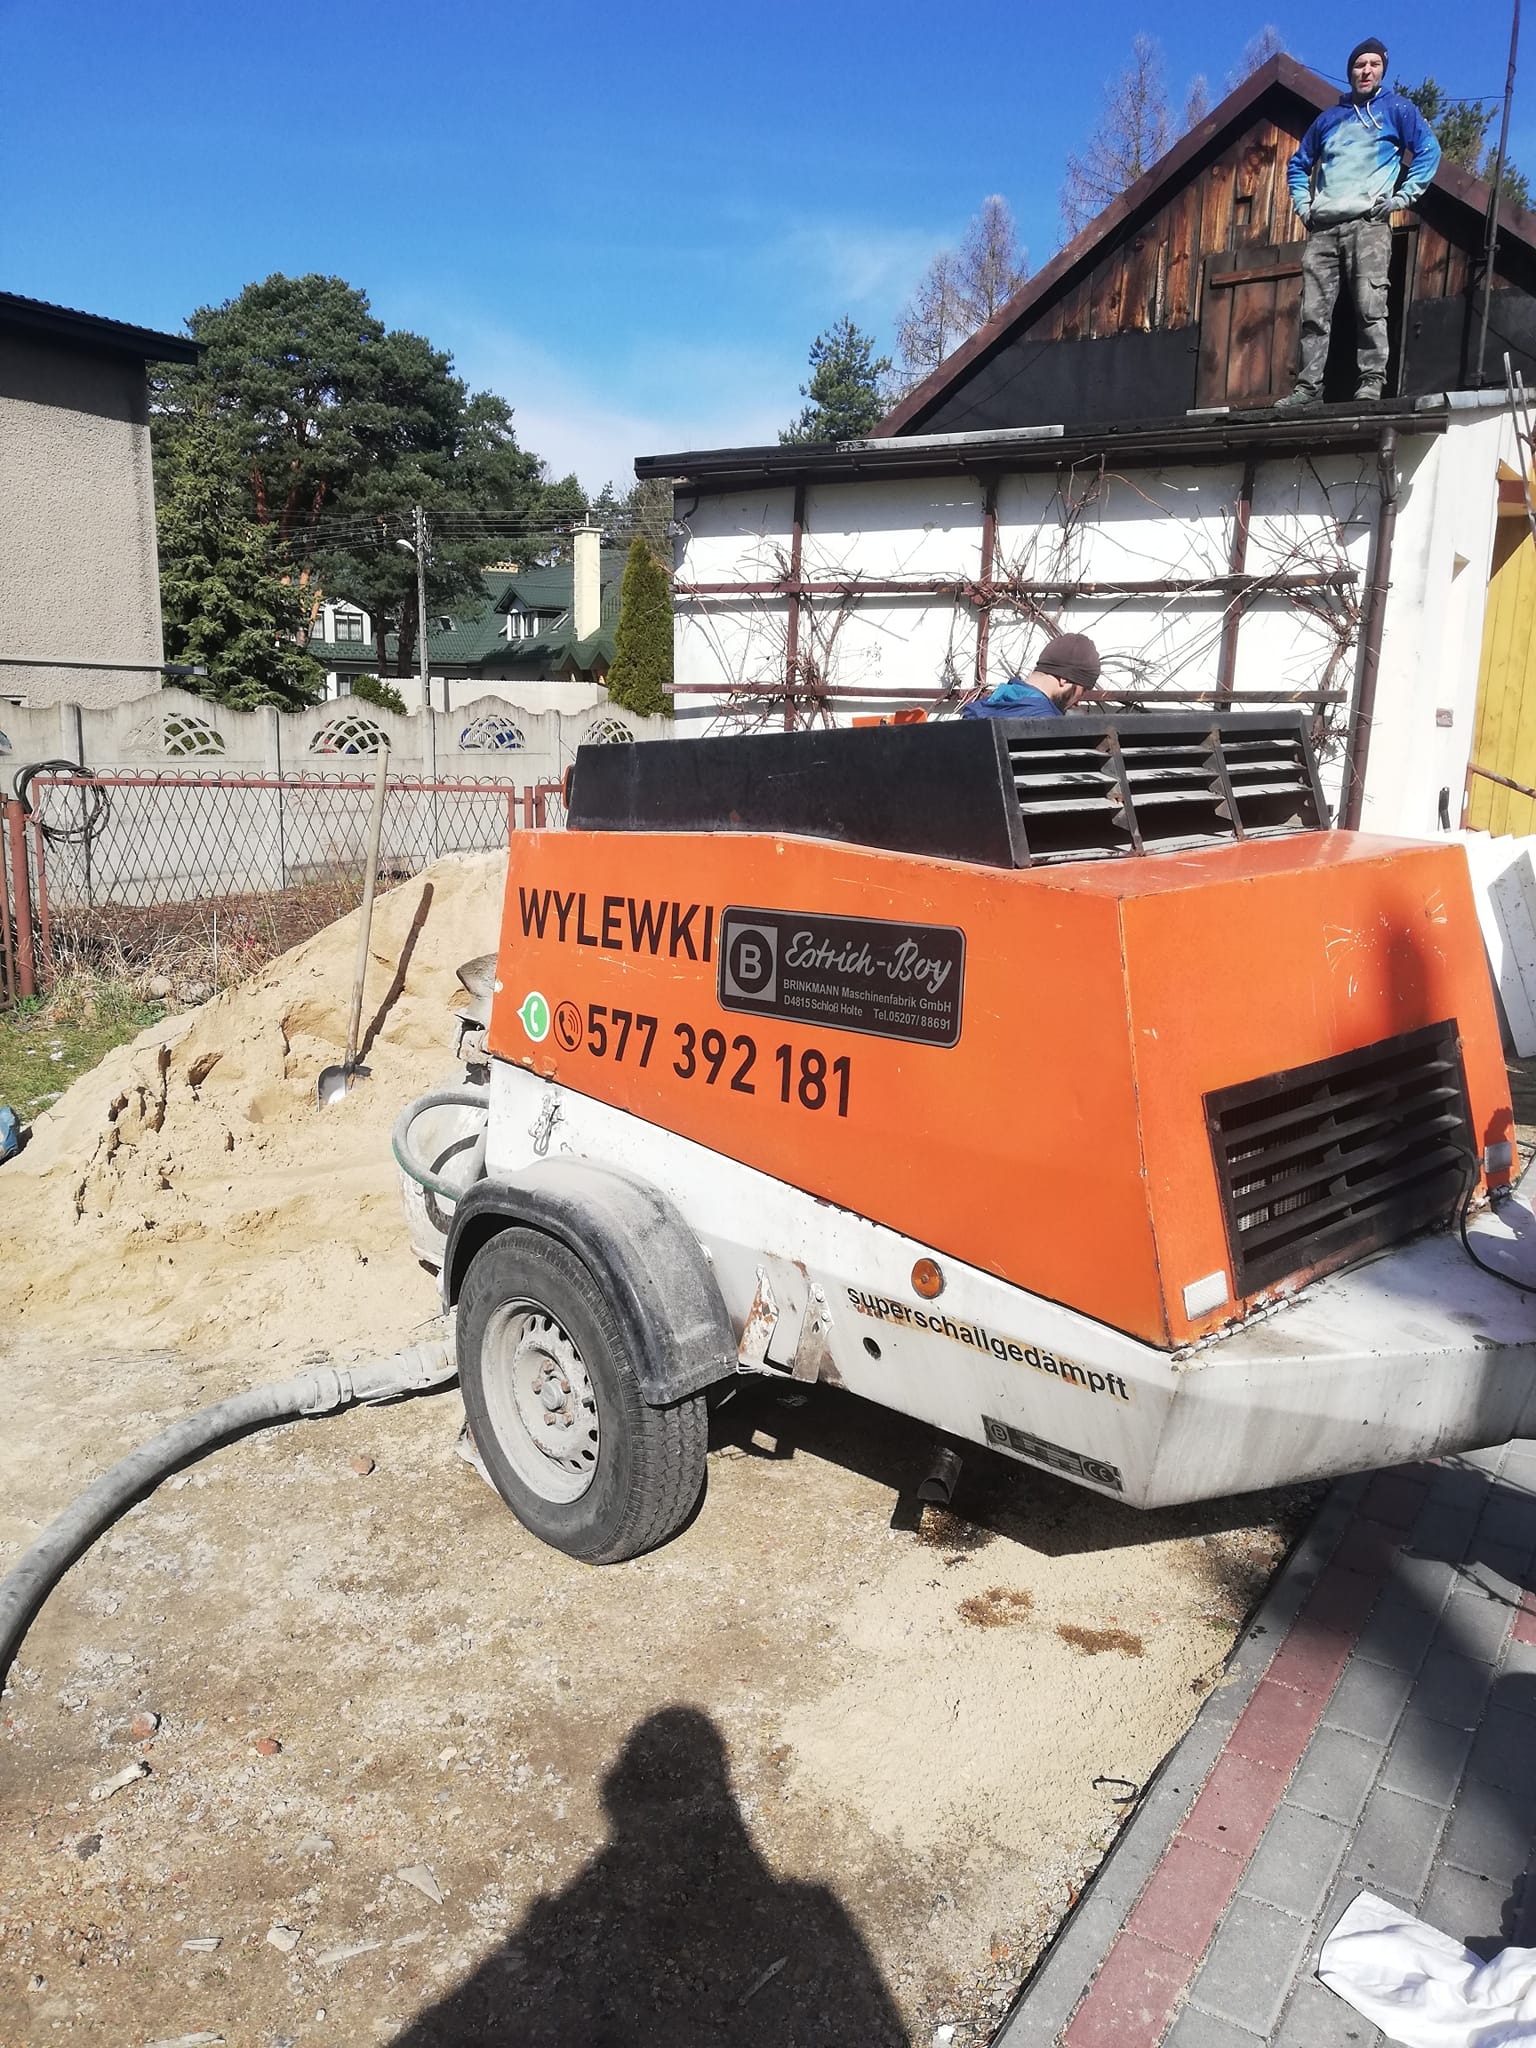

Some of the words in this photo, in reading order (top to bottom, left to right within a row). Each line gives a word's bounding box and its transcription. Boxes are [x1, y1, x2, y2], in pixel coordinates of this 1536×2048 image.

[518, 887, 714, 962] WYLEWKI
[739, 943, 762, 979] B
[784, 931, 952, 994] Estrich-Boy
[784, 978, 840, 996] BRINKMANN
[841, 986, 917, 1008] Maschinenfabrik
[919, 998, 952, 1013] GmbH
[784, 994, 811, 1009] D4815
[811, 998, 839, 1013] Schloß
[840, 1003, 863, 1017] Holte
[920, 1015, 951, 1031] 88691
[587, 1003, 659, 1069] 577
[672, 1023, 757, 1095] 392
[775, 1043, 852, 1118] 181
[847, 1287, 1130, 1401] superschallgedämpft
